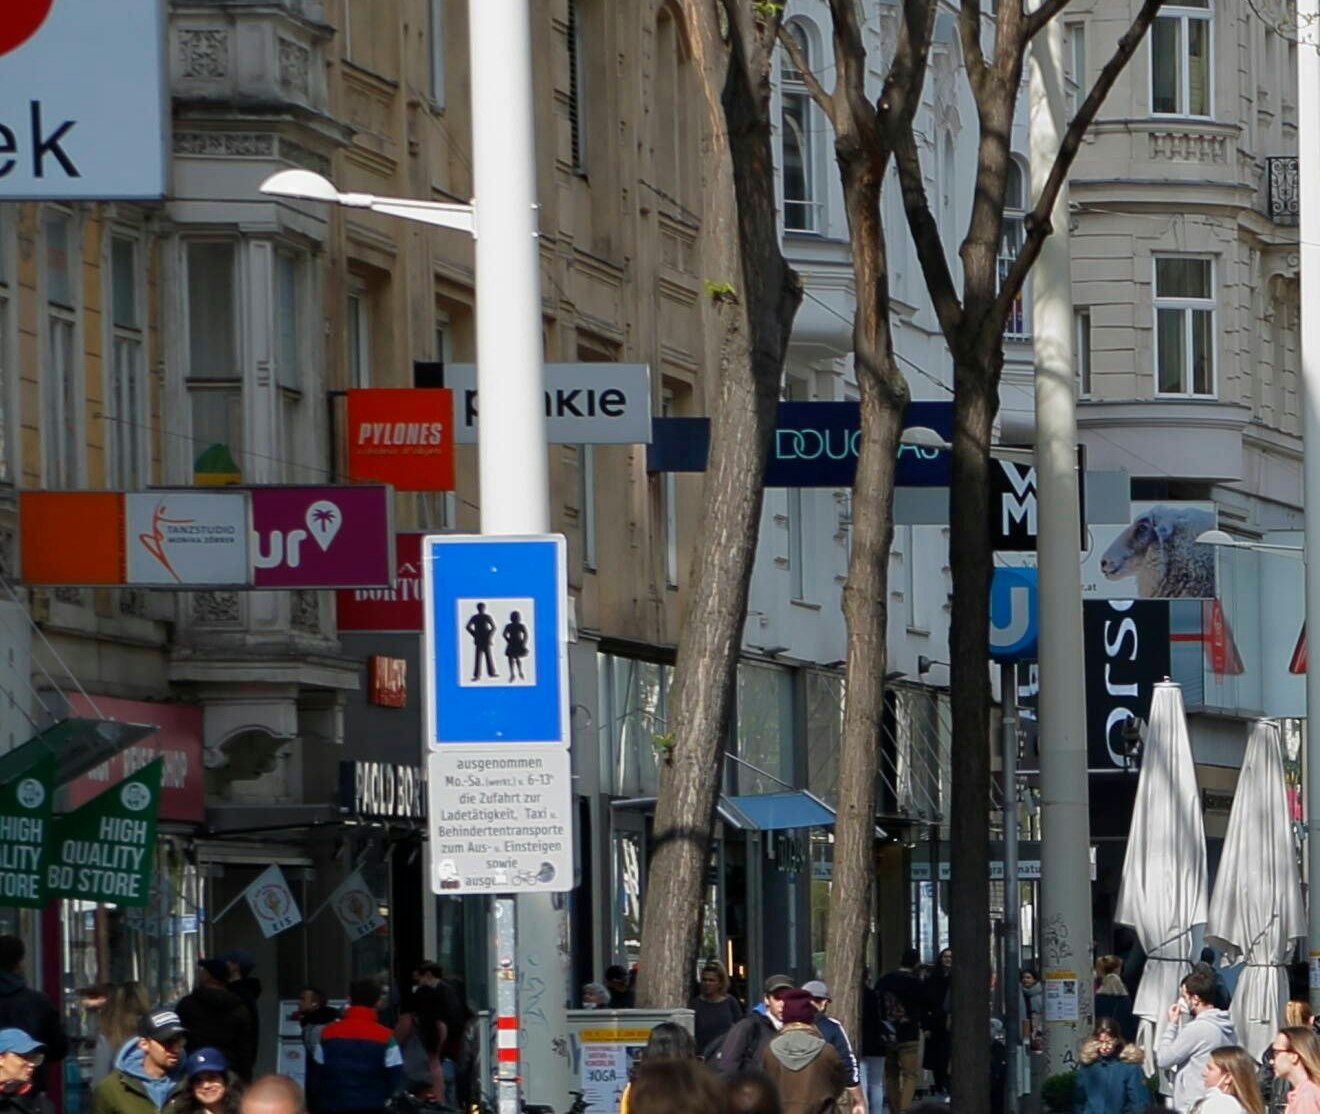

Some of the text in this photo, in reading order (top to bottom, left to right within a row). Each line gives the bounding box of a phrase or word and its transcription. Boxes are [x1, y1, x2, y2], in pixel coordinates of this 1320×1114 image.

[465, 388, 627, 426] pkie
[358, 422, 443, 445] PYLONES
[775, 429, 939, 460] DOUAS
[167, 525, 235, 534] TANZSTUDIO
[457, 758, 543, 772] ausgenommen
[459, 792, 542, 804] die Zufahrt zur
[441, 809, 518, 823] Ladetätigkeit,
[525, 807, 547, 819] Taxi
[100, 816, 147, 844] HIGH
[438, 825, 564, 838] Behindertentransporte
[62, 839, 145, 871] QUALITY
[441, 844, 464, 854] zum
[467, 842, 493, 853] Aus-
[504, 841, 562, 854] Einsteigen
[486, 857, 519, 869] sowie
[77, 868, 141, 898] STORE
[271, 916, 293, 932] EIS
